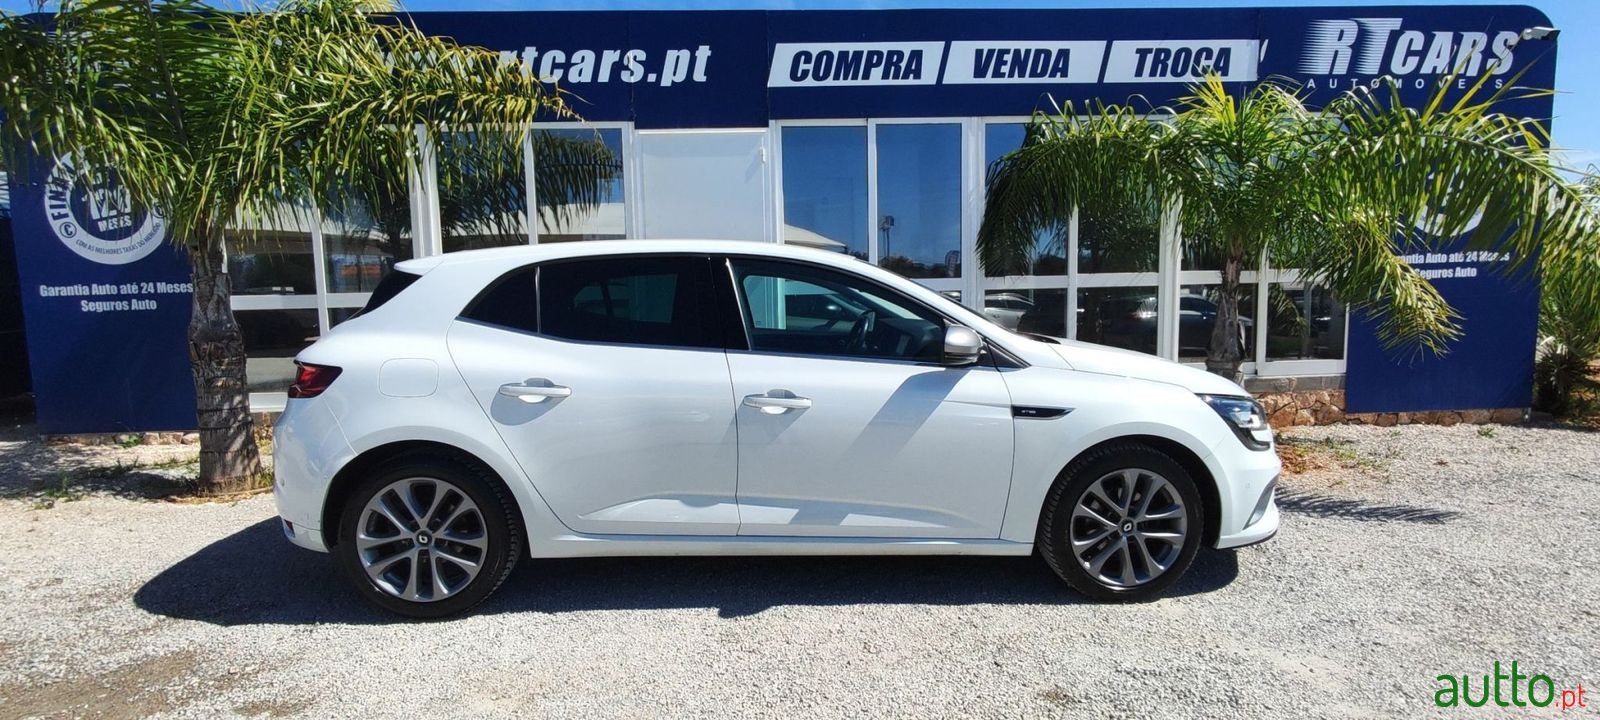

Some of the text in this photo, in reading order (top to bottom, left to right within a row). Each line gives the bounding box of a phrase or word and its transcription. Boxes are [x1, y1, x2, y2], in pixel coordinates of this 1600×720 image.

[789, 50, 923, 82] COMPRA
[973, 49, 1071, 79] VENDA
[1134, 47, 1232, 78] TROCA
[1425, 252, 1448, 264] Auto
[1466, 251, 1478, 262] 24
[1454, 267, 1478, 278] Auto
[39, 281, 194, 297] Garantia Auto até 24 Meses
[81, 299, 157, 313] Seguros Auto
